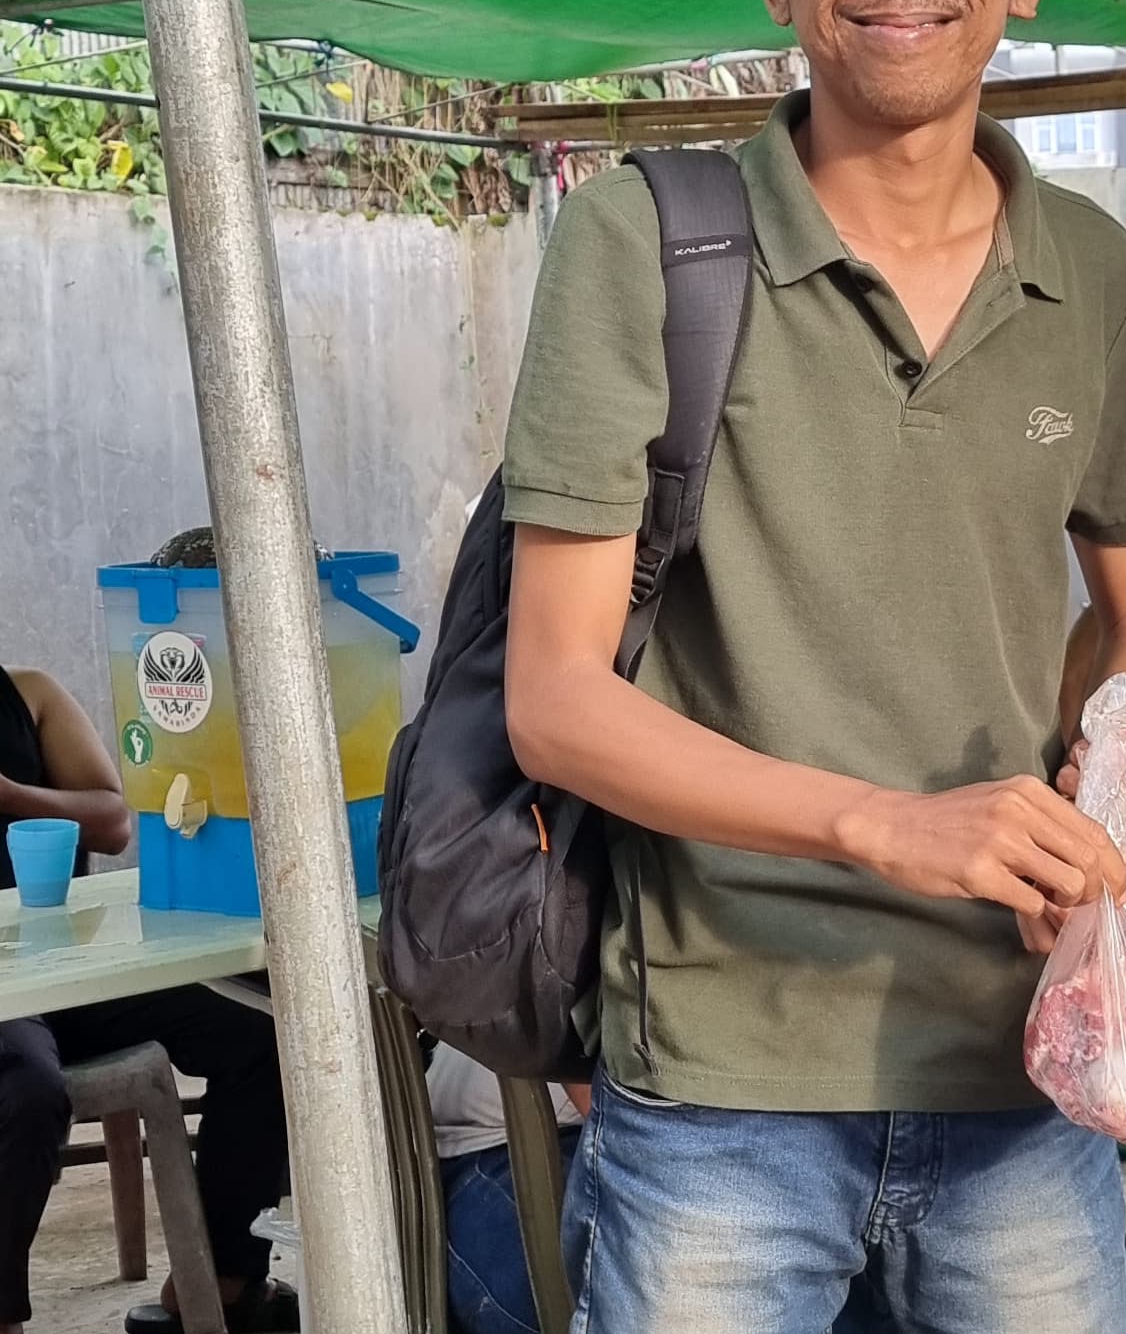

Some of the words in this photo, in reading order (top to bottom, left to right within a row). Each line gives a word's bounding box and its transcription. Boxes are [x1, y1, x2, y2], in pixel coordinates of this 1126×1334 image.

[675, 242, 727, 256] KALIBRE
[148, 685, 174, 696] ANIMAL
[175, 686, 204, 698] RESCUE
